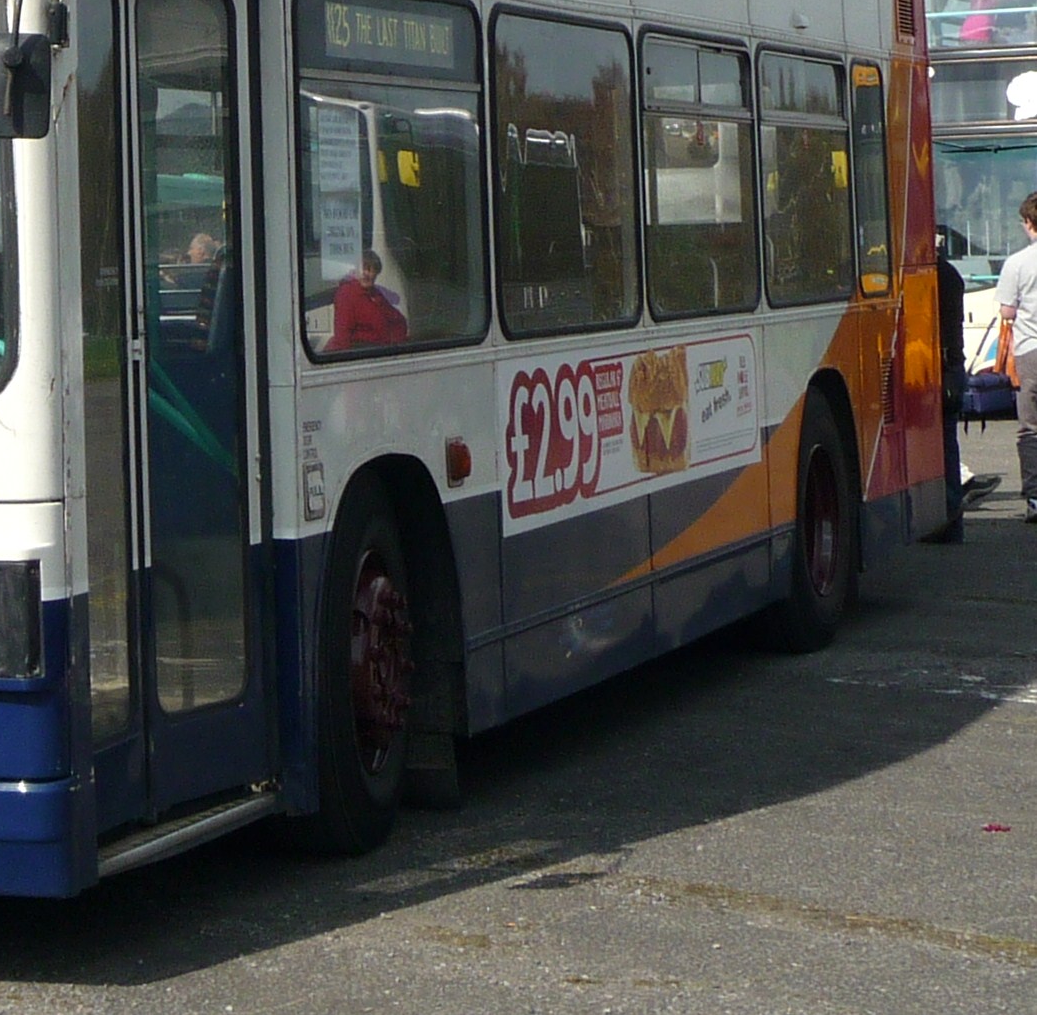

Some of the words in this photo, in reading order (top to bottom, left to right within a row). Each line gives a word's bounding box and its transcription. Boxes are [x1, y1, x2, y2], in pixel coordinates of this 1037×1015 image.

[355, 12, 373, 46] THE
[376, 15, 399, 49] LAST
[510, 371, 599, 504] £2.99
